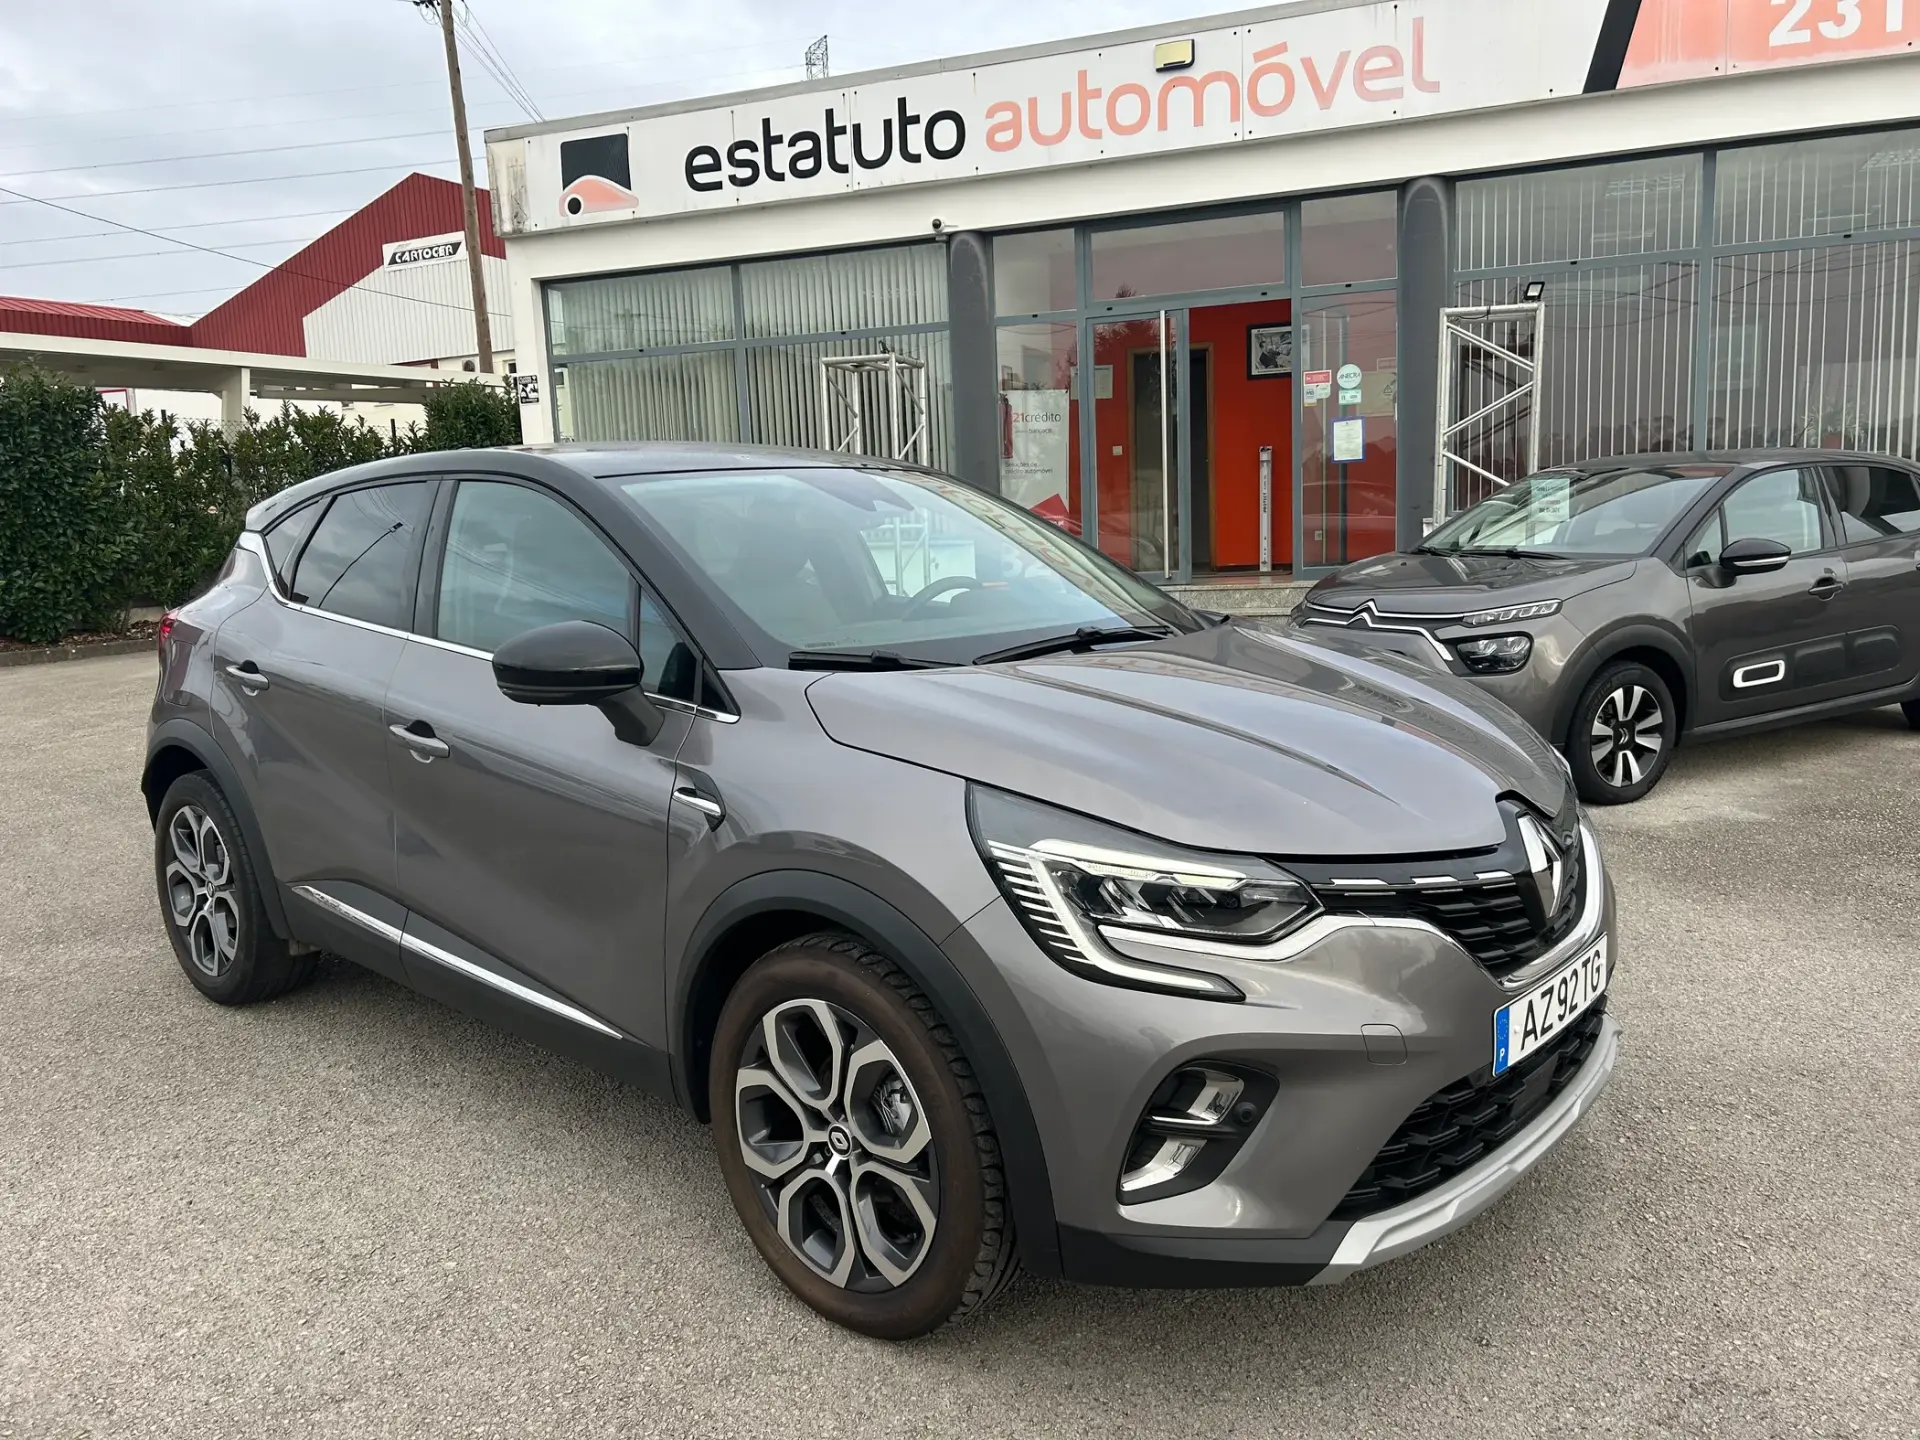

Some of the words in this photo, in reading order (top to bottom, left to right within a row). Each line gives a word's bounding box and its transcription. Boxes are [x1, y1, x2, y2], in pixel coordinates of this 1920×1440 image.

[684, 96, 966, 192] estatuto
[984, 19, 1439, 153] automóvel
[395, 244, 454, 263] CARTOCER
